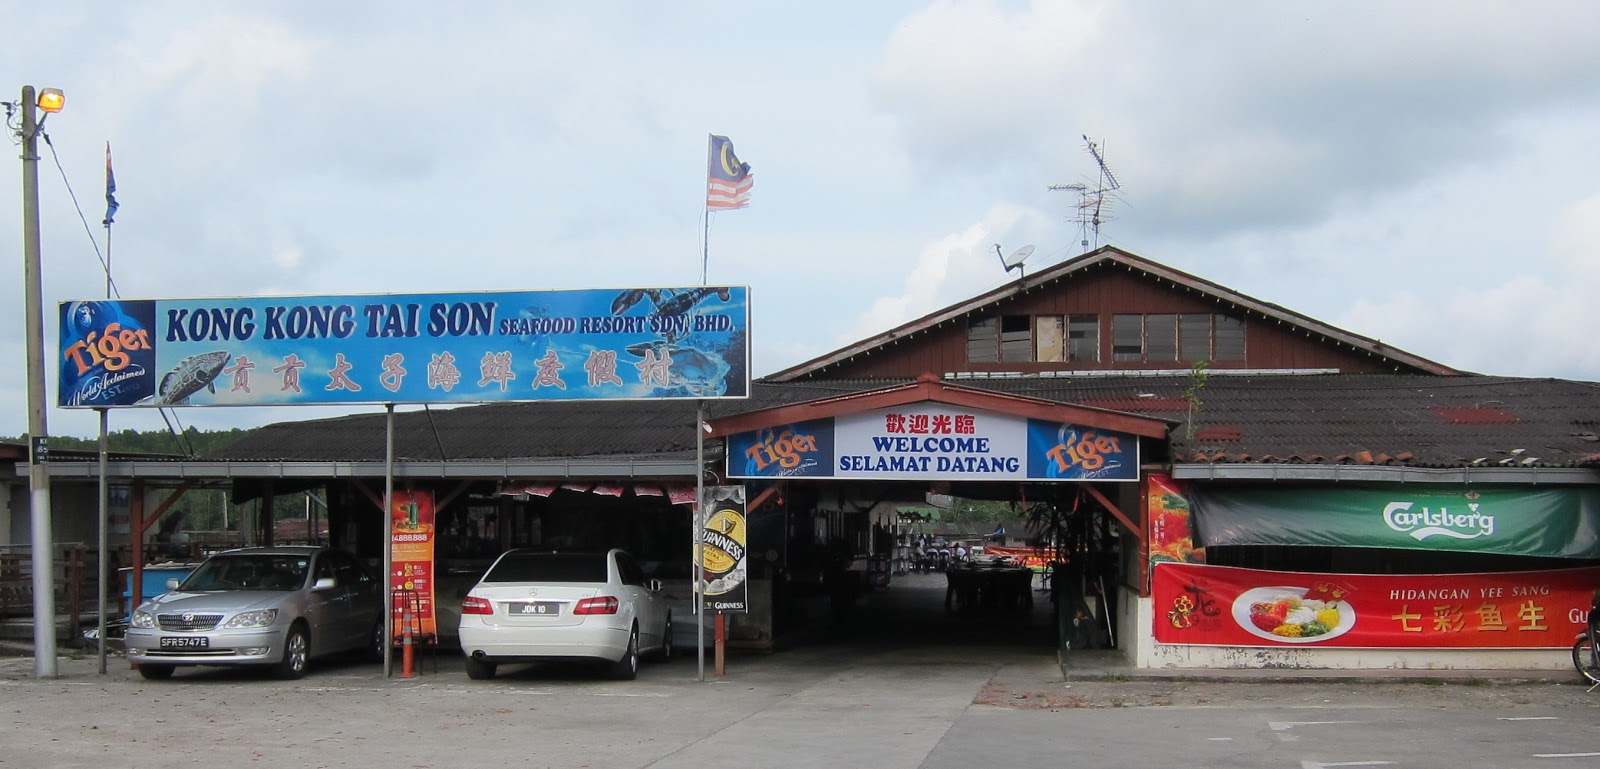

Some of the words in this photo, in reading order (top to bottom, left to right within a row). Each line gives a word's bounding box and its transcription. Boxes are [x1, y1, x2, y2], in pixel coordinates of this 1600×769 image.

[166, 307, 255, 342] KONG
[263, 305, 356, 341] KONG
[364, 303, 421, 339] TAI
[427, 301, 498, 337] SON
[499, 317, 577, 335] SEAFOOD
[580, 316, 649, 334] RESORT
[693, 314, 735, 332] BHD.
[64, 322, 152, 376] Tiger
[98, 364, 146, 391] Acclaimed
[886, 414, 975, 435] 歡迎光臨
[745, 430, 818, 471] Tiger
[872, 436, 990, 453] WELCOME
[1046, 431, 1122, 473] Tiger
[840, 456, 931, 472] SELAMAT
[937, 456, 1020, 473] DATANG
[1383, 502, 1494, 541] Carlsberg
[703, 528, 743, 561] UINNESS
[714, 601, 744, 610] GUINNESS
[1389, 588, 1470, 600] HIDANGAN
[1480, 587, 1504, 598] YEE
[1511, 584, 1550, 597] SANG
[1391, 599, 1549, 632] 七彩鱼生
[161, 637, 207, 647] SFR5747E
